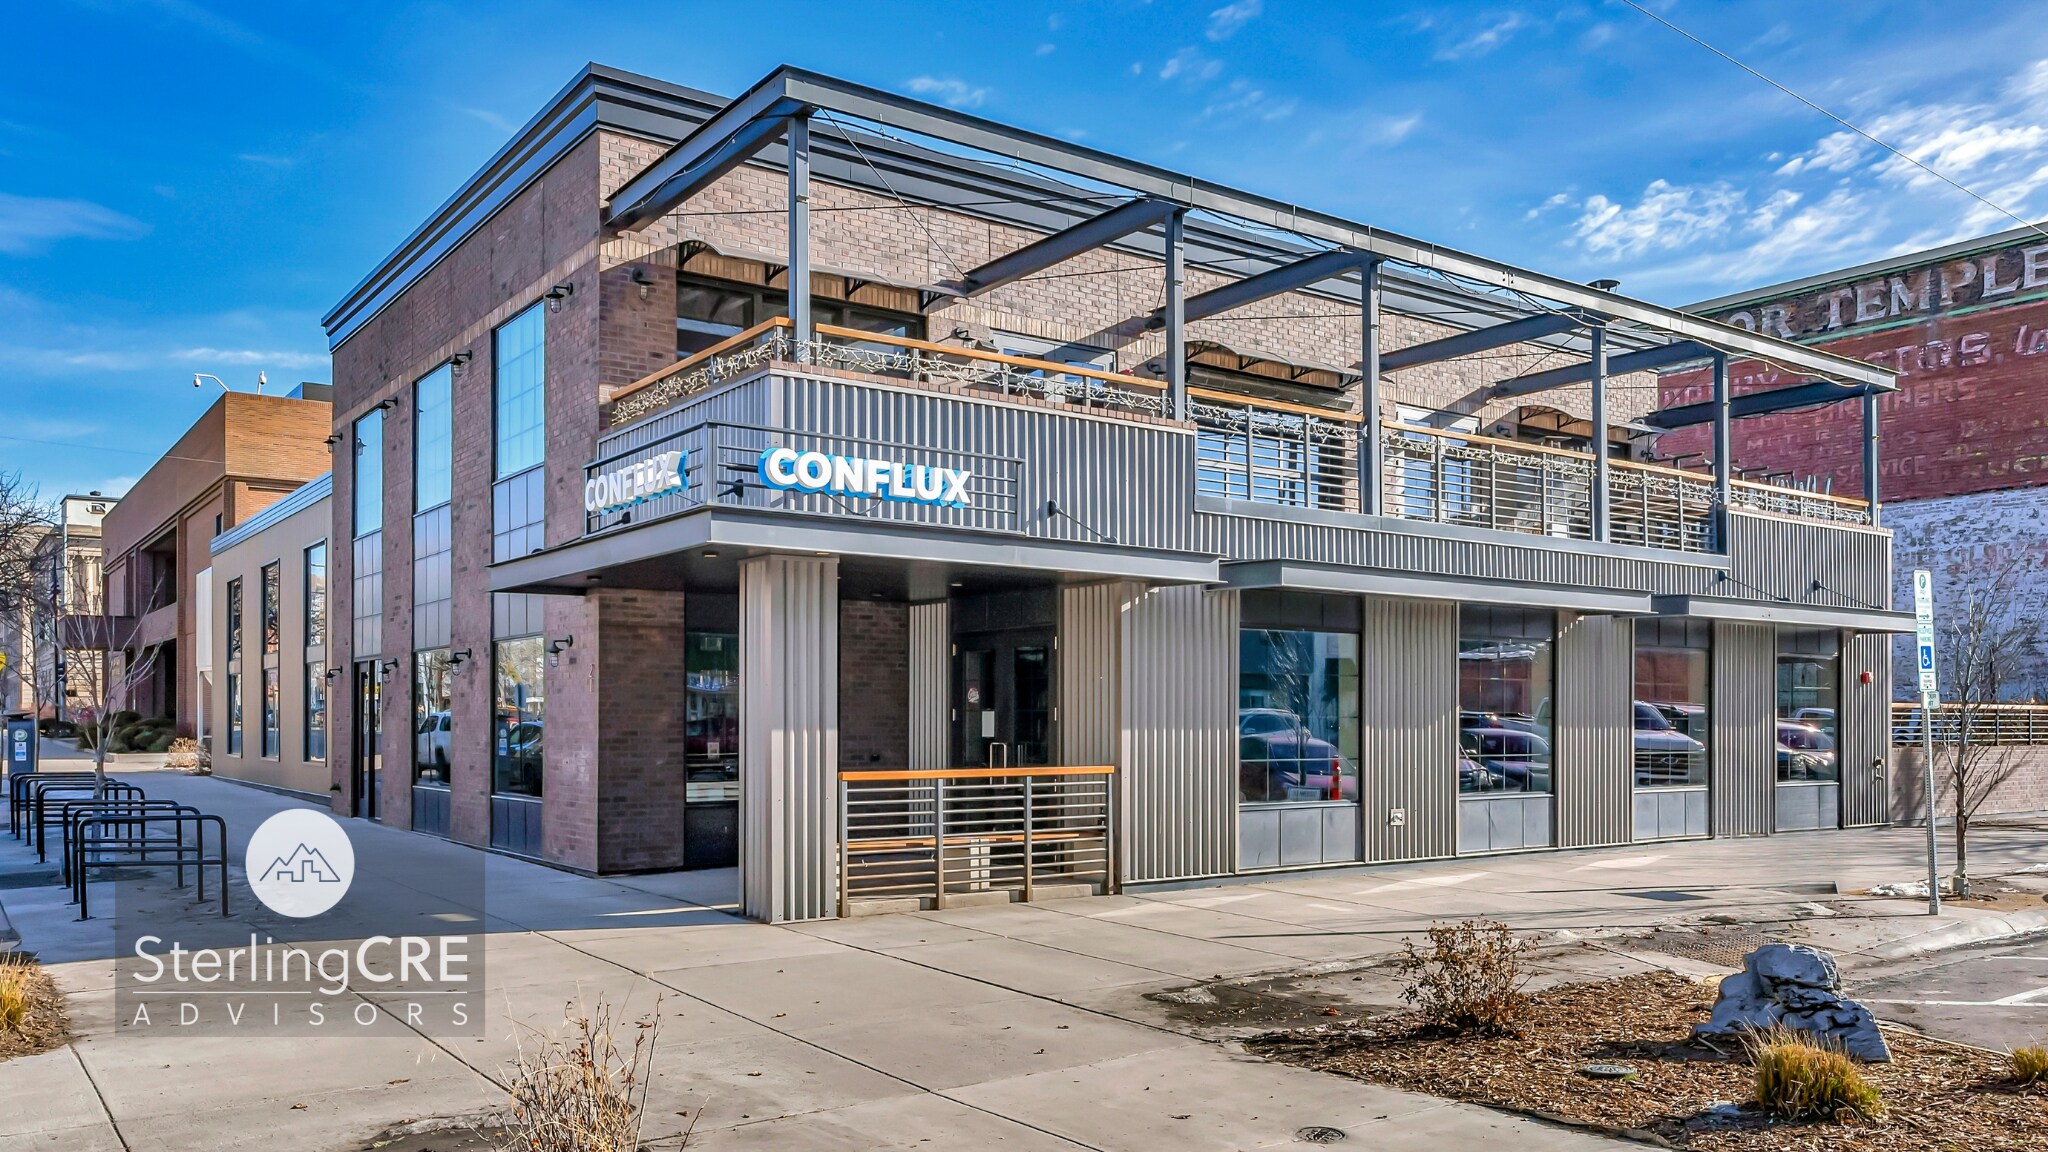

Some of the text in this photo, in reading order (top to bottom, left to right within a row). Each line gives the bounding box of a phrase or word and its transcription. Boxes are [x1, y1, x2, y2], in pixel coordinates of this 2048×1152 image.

[1818, 244, 2048, 329] TEMPLE
[585, 449, 687, 514] CONFLUX
[759, 447, 972, 508] CONFLUX
